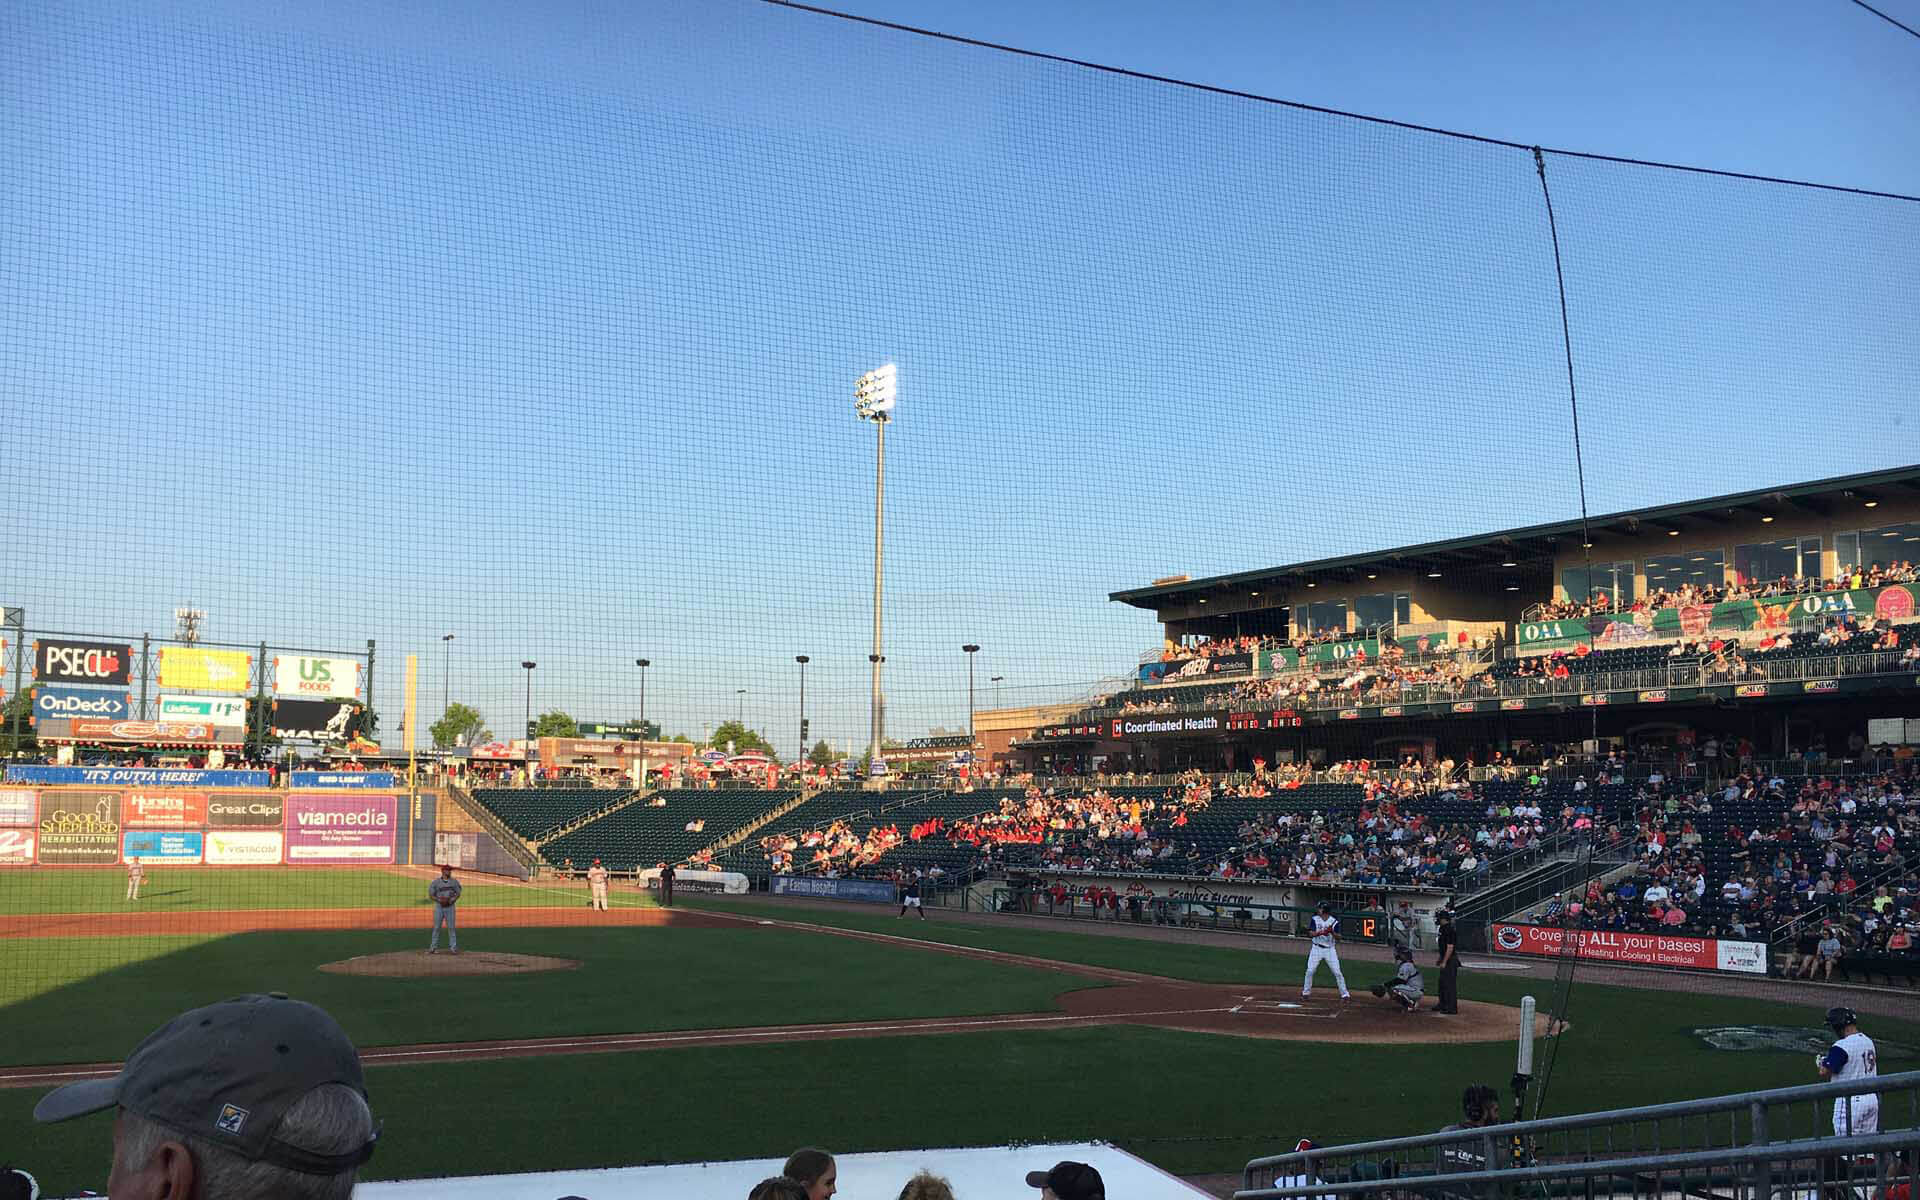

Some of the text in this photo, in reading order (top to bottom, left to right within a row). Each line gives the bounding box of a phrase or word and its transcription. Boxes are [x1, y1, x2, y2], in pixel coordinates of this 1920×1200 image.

[1803, 593, 1856, 613] OAA
[1525, 623, 1564, 641] OAA
[46, 646, 110, 678] PSECU
[299, 682, 331, 692] FOODS
[1815, 681, 1839, 690] NEWS
[1124, 719, 1183, 734] Coordinated
[1184, 717, 1218, 731] Health
[276, 729, 345, 740] MACK
[113, 771, 156, 782] OUTTA
[209, 803, 281, 817] Great Clips
[297, 808, 388, 826] viamedia
[41, 836, 117, 844] REHABILITATION
[812, 879, 837, 896] Hospital
[1363, 919, 1376, 938] 12
[1590, 931, 1619, 947] ALL
[1623, 937, 1655, 951] your
[1657, 937, 1705, 953] bases!
[1584, 947, 1614, 959] Heating
[1621, 950, 1651, 961] Cooling
[1658, 953, 1695, 965] Electrical
